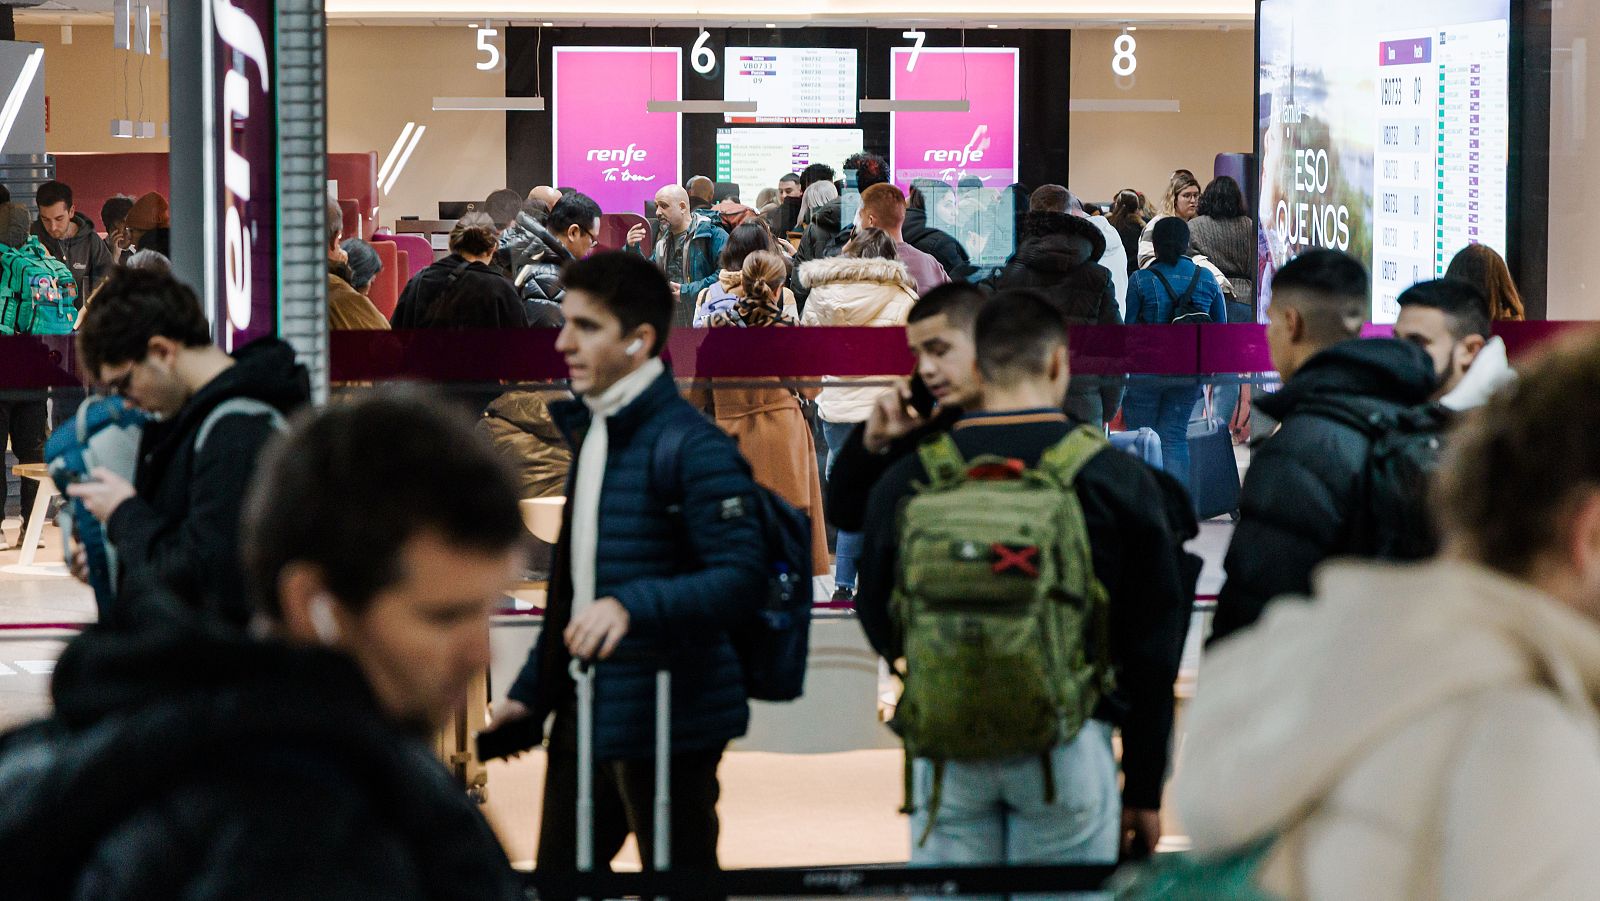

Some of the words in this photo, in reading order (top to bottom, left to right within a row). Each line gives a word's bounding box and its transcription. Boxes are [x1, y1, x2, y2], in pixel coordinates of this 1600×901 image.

[476, 28, 500, 70] 5
[691, 30, 716, 73] 6
[902, 32, 926, 72] 7
[1112, 34, 1136, 76] 8
[1381, 77, 1401, 105] VB0733
[1413, 76, 1421, 104] 09
[586, 143, 647, 167] renfe
[602, 168, 619, 182] Tu
[923, 143, 984, 167] renfe
[1295, 149, 1328, 193] ESO
[1276, 199, 1309, 247] QUE
[1312, 203, 1349, 251] NOS
